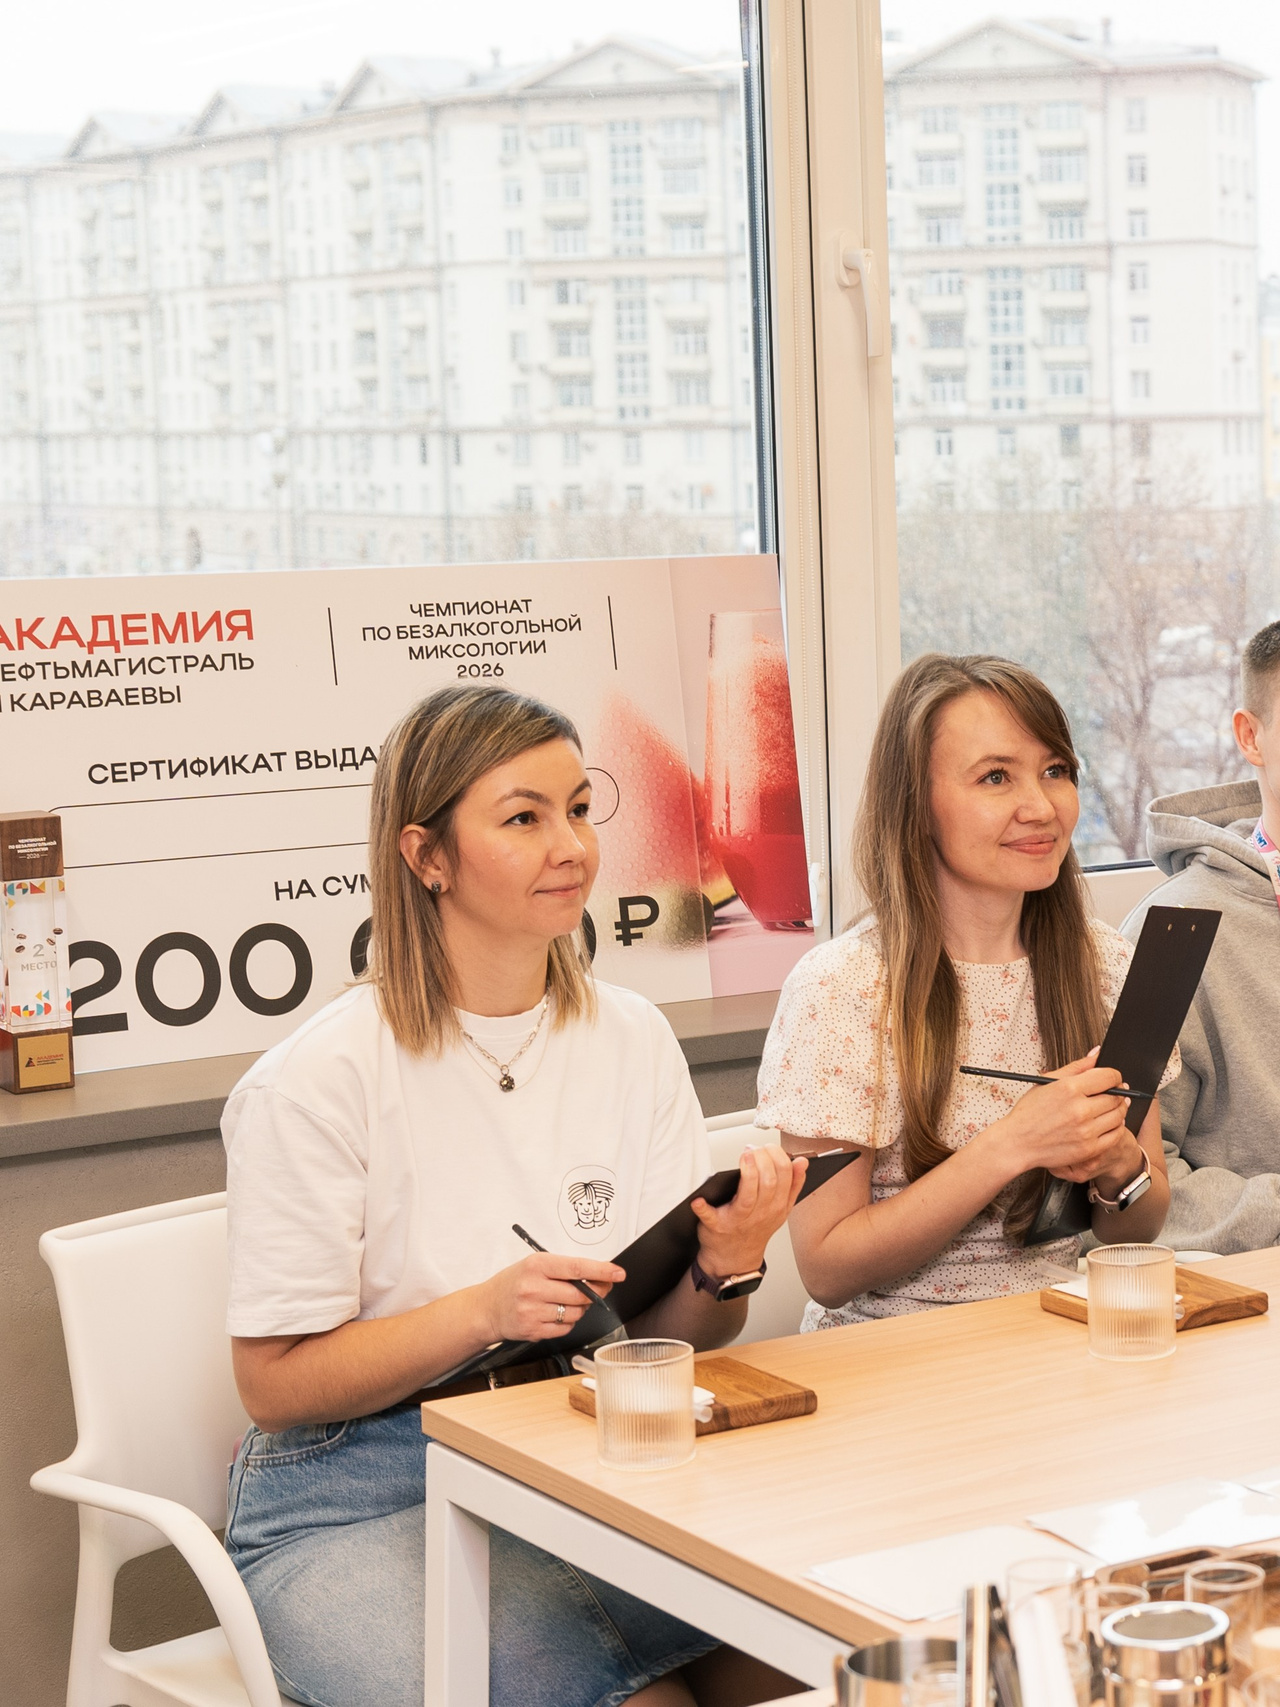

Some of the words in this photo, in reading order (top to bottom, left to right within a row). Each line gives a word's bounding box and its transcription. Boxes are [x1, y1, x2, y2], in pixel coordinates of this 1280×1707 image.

[410, 599, 532, 618] ЧЕМПИОНАТ
[362, 626, 391, 642] ПО
[397, 613, 582, 640] БЕЗАЛКОГОЛЬНОЙ
[408, 640, 547, 661] МИКСОЛОГИИ
[457, 663, 504, 678] 2026
[10, 685, 182, 713] КАРАВАЕВЫ
[88, 752, 288, 785] СЕРТИФИКАТ
[295, 745, 383, 771] ВЫДА
[274, 878, 317, 901] НА
[33, 944, 45, 958] 2
[21, 960, 58, 972] МЕСТО
[69, 922, 313, 1036] 200
[614, 895, 660, 947] ₽
